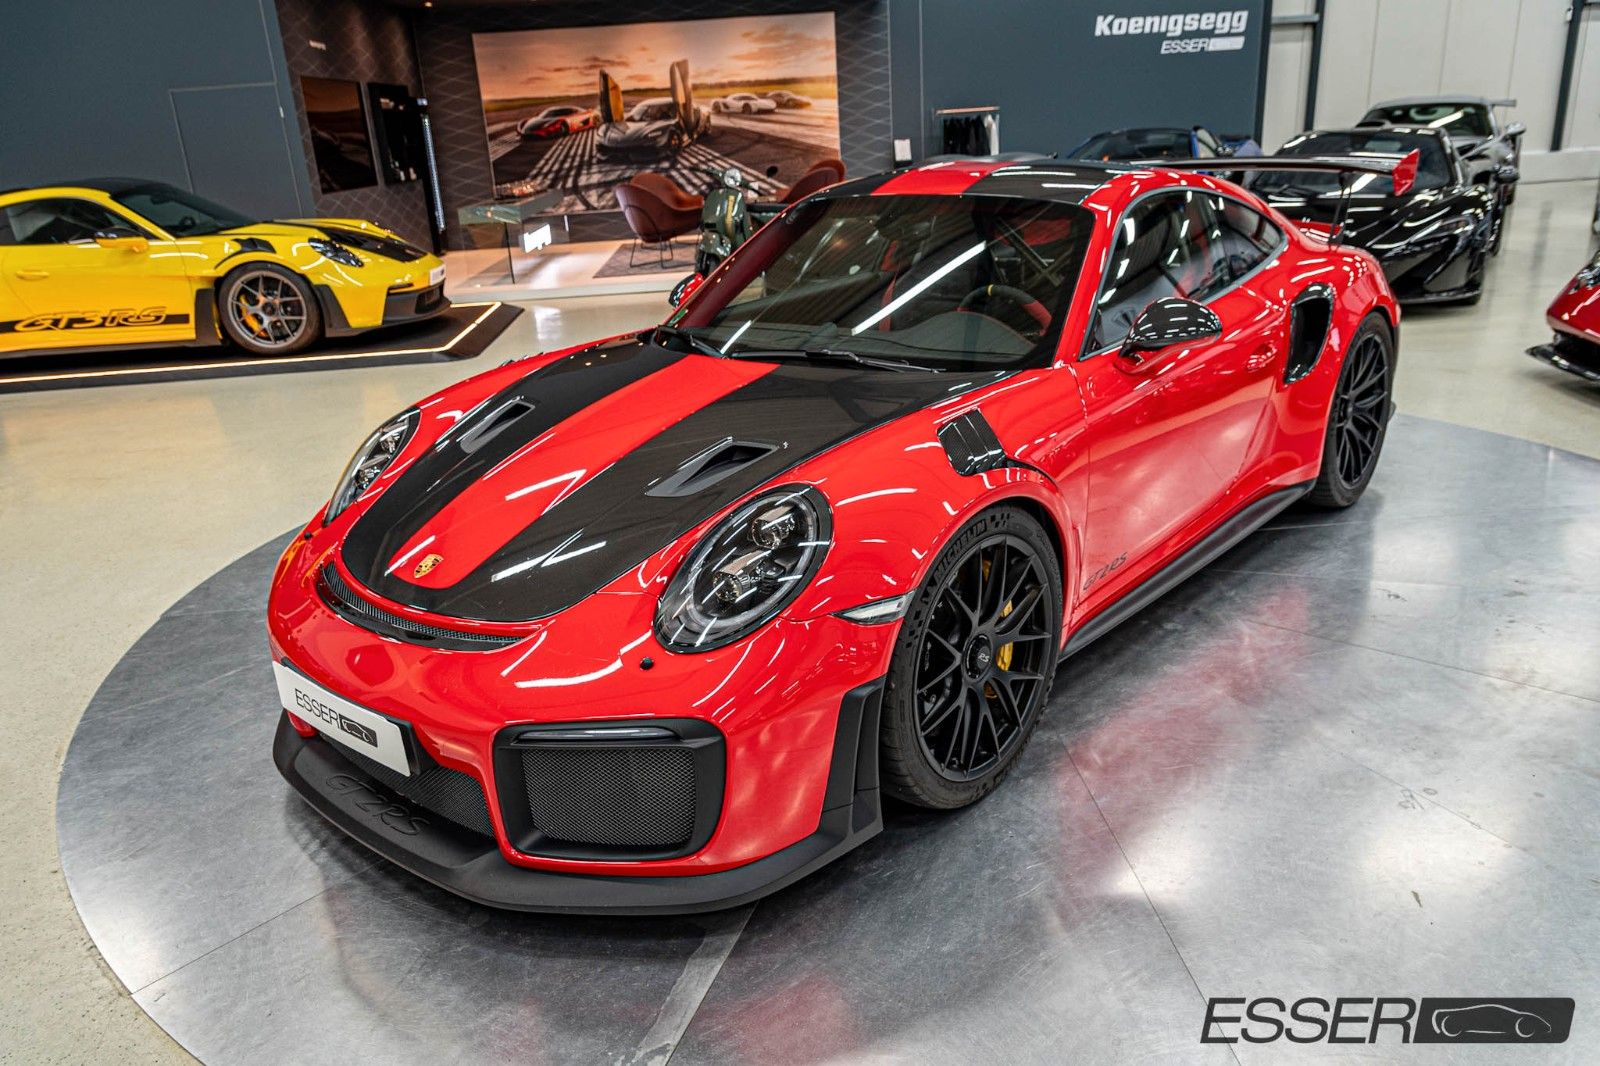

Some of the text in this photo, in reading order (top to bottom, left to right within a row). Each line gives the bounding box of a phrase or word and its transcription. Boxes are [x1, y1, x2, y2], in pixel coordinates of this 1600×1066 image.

[1094, 10, 1249, 37] Koenigsegg
[1160, 38, 1210, 54] ESSER
[932, 518, 988, 582] MICHELIN
[294, 687, 341, 730] ESSER
